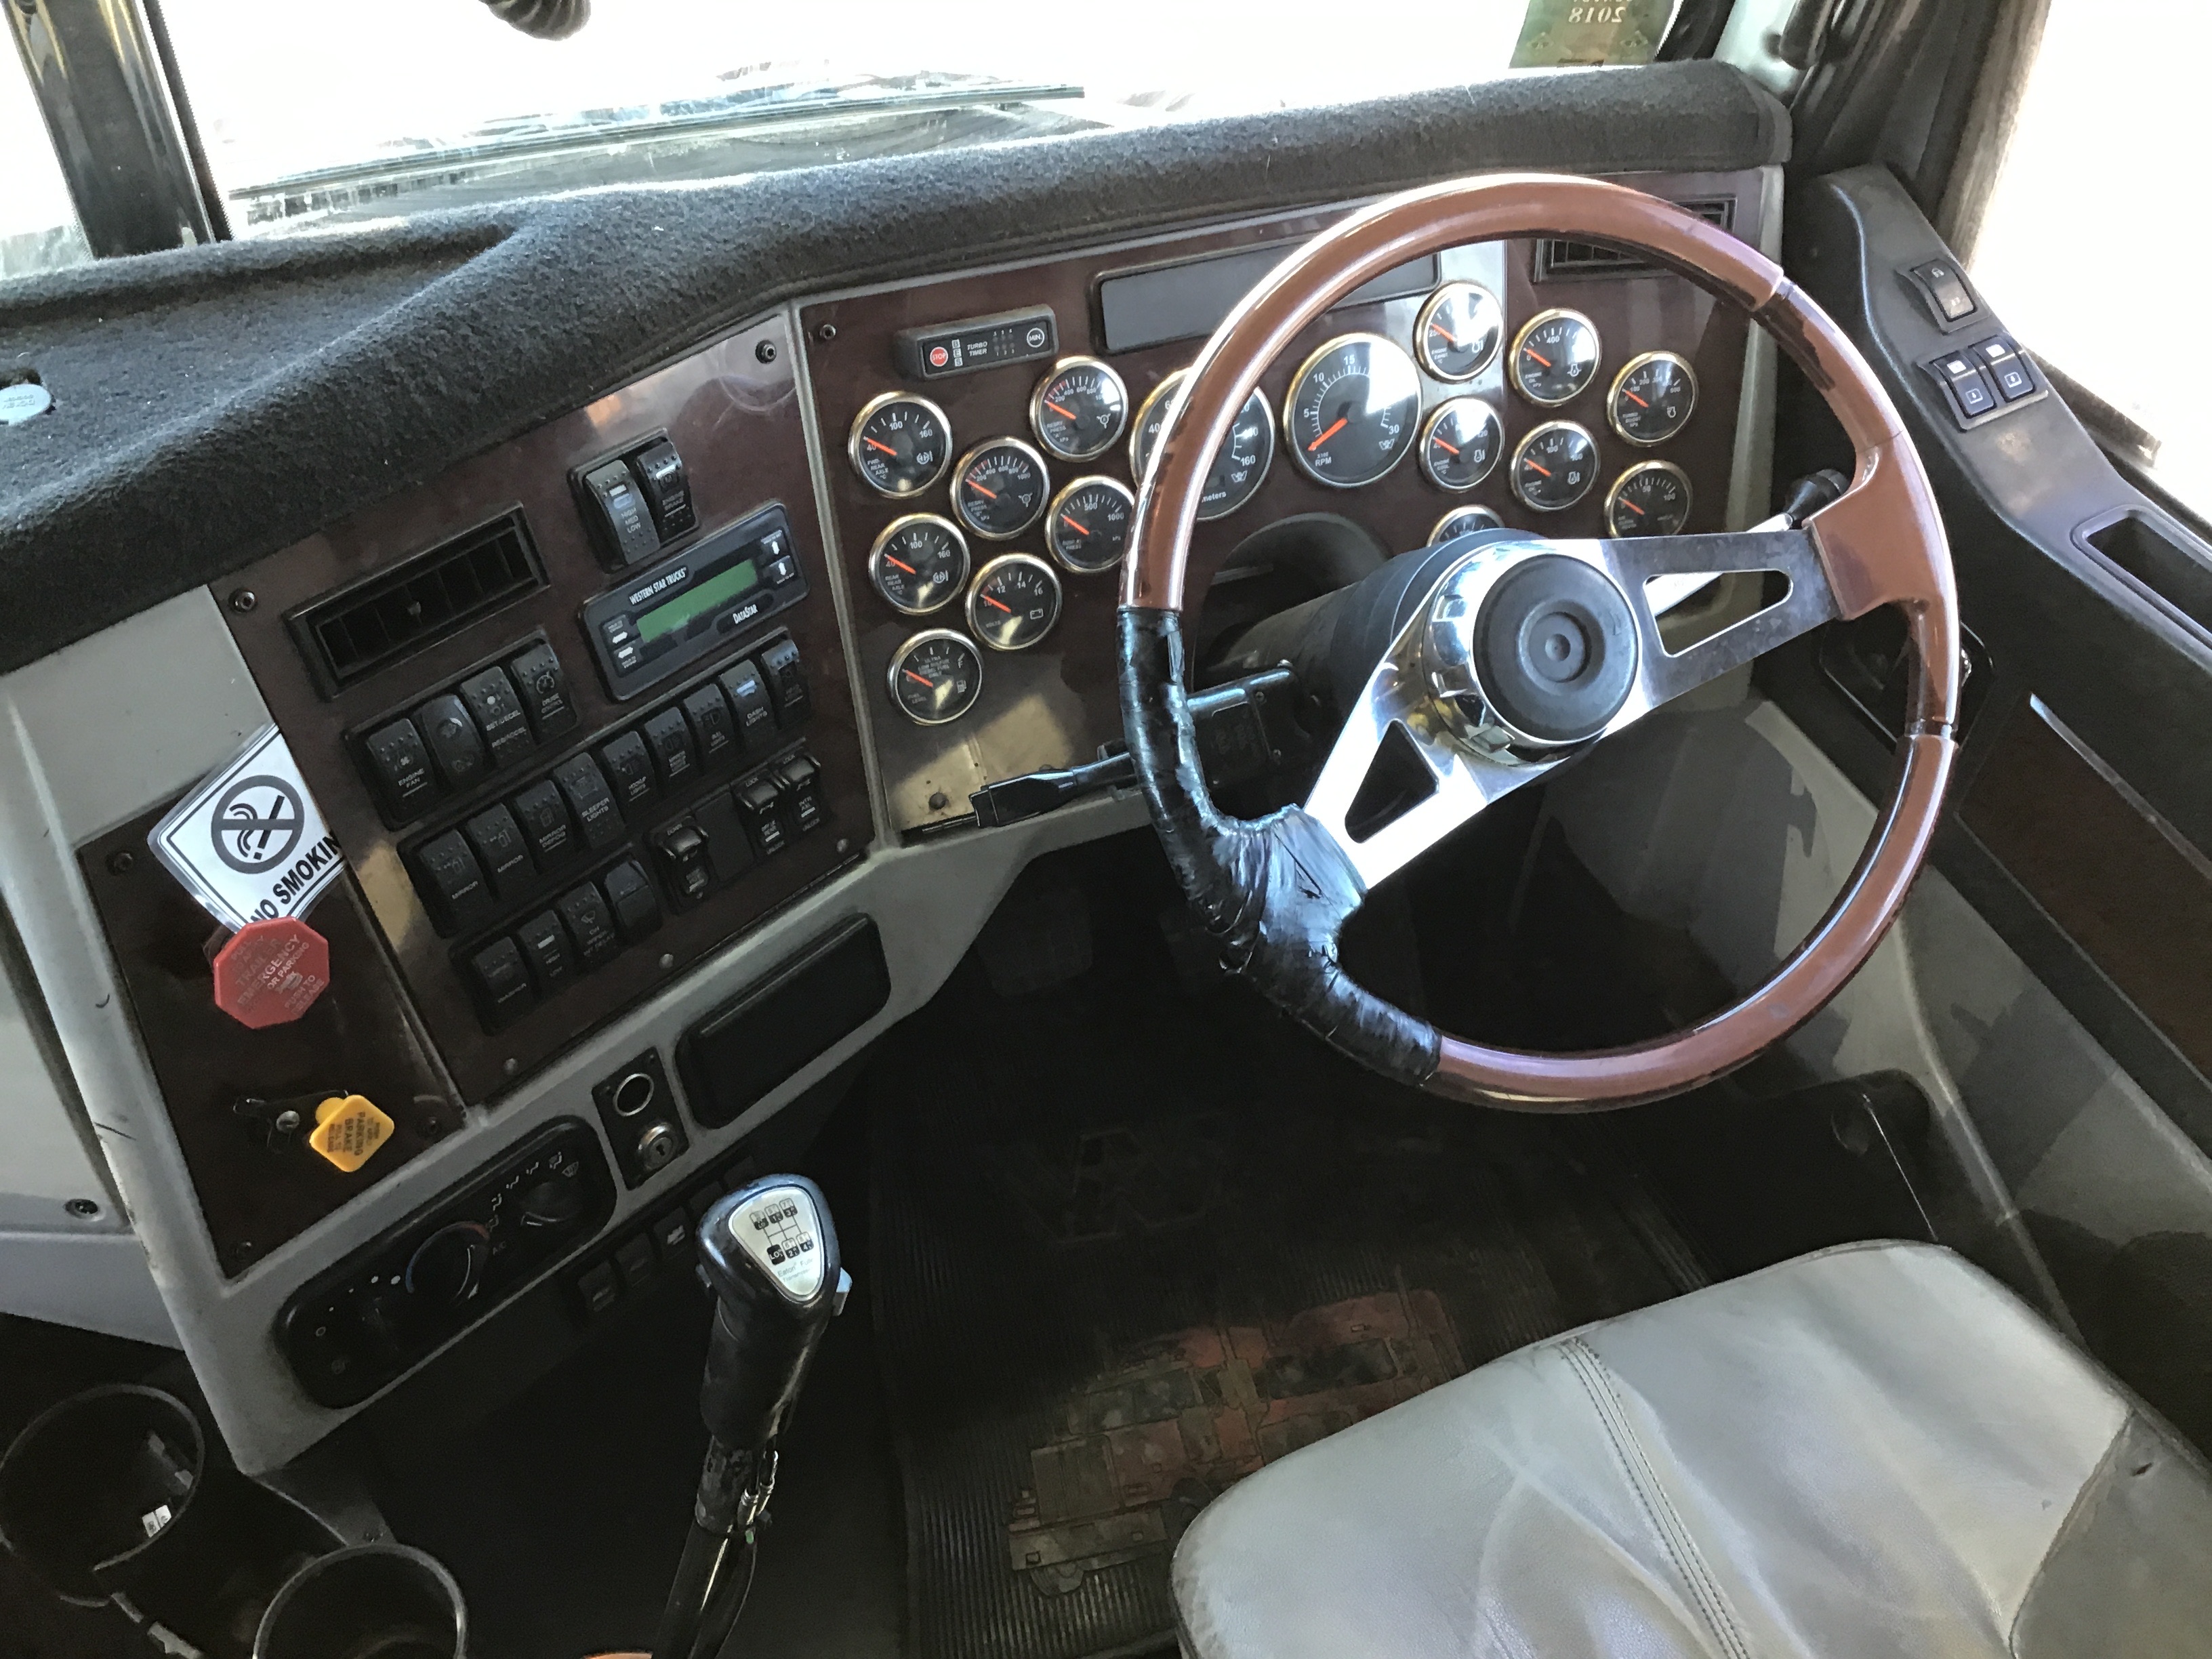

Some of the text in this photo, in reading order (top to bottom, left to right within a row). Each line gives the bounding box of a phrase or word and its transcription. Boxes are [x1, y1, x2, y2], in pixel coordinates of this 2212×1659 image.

[1546, 335, 1560, 344] 400
[967, 342, 988, 350] TURBO
[931, 352, 946, 361] STOP
[969, 348, 987, 356] TIMER
[1344, 354, 1355, 365] 15
[1313, 372, 1325, 383] 10
[1303, 409, 1309, 418] 5
[889, 421, 903, 430] 100
[1148, 423, 1160, 434] 40
[1389, 424, 1399, 434] 30
[920, 428, 933, 438] 160
[1240, 455, 1256, 466] 160
[1315, 457, 1332, 466] RPM
[621, 507, 636, 518] HIGH
[1084, 503, 1098, 511] 500
[625, 515, 638, 525] MED
[1107, 512, 1124, 521] 1000
[627, 522, 641, 533] LOW
[909, 541, 922, 549] 100
[937, 550, 951, 558] 160
[997, 585, 1006, 594] 12
[1017, 581, 1026, 589] 14
[629, 586, 655, 605] WESTERN
[653, 577, 668, 594] STAR
[1034, 587, 1043, 596] 16
[783, 754, 796, 764] LOCK
[398, 768, 425, 786] ENGINE
[406, 777, 421, 788] FAN
[745, 777, 759, 787] LOCK
[581, 797, 610, 817] SLEEPER
[586, 806, 609, 822] LIGHTS
[539, 824, 567, 844] MIRROR
[497, 855, 524, 874] MIRROR
[251, 830, 342, 922] NO SMOKIN
[451, 880, 478, 900] MIRROR
[235, 938, 282, 986] TRAILER
[267, 977, 281, 989] OR
[278, 942, 310, 977] PARKING
[238, 934, 300, 1006] EMERGENCY
[285, 985, 306, 1008] PUSH
[302, 975, 315, 986] TO
[291, 978, 325, 1015] RELEASE
[344, 1118, 354, 1153] BRAKE
[354, 1112, 365, 1156] PARKING
[769, 1250, 780, 1260] LO
